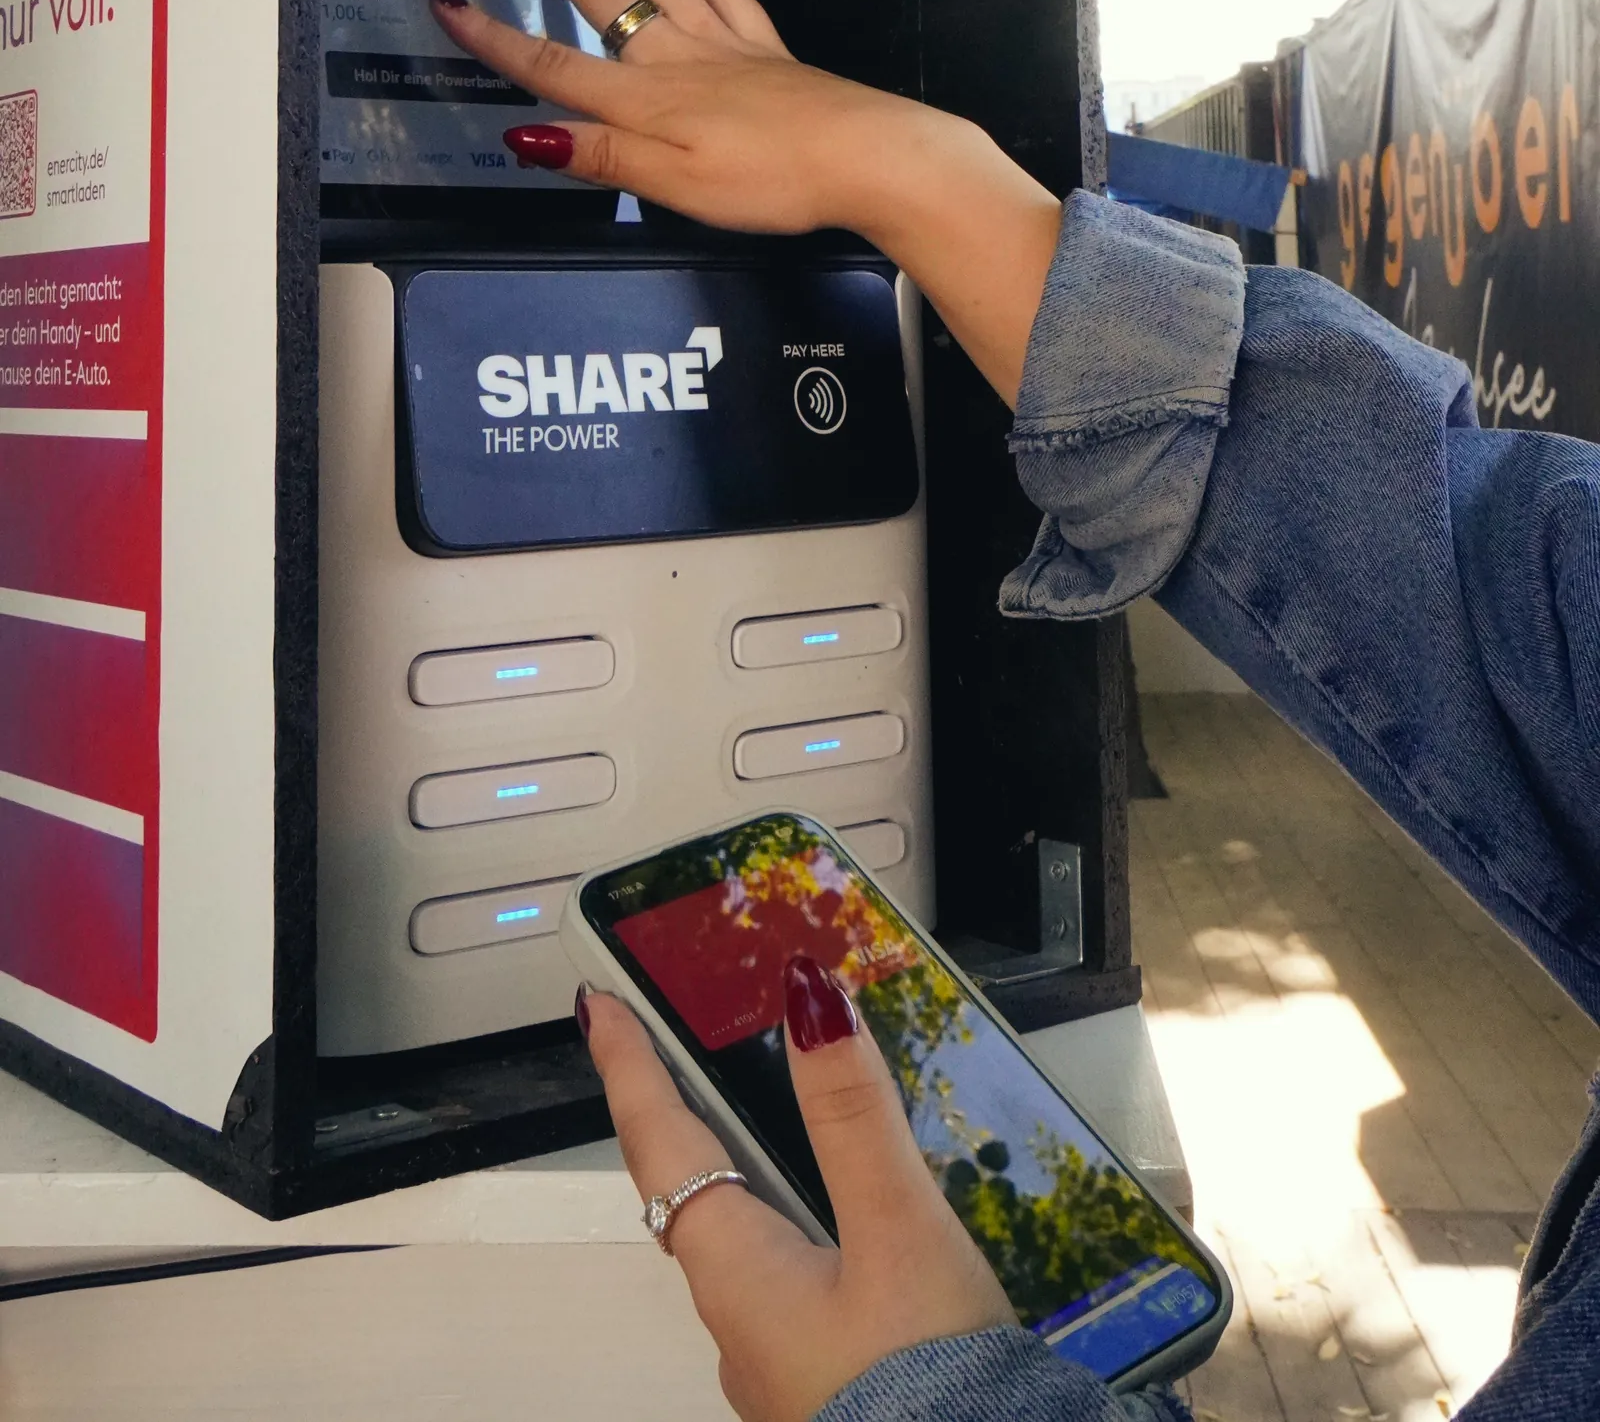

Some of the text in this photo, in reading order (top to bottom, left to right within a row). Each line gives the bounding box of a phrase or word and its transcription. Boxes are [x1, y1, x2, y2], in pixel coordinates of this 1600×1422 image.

[321, 3, 367, 22] 1,00€
[354, 68, 513, 90] Hol Dir eine Powerbank!
[46, 145, 110, 176] enercity.de/
[332, 149, 356, 165] Pay
[470, 152, 508, 168] VISA
[46, 180, 106, 207] smartladen
[24, 279, 57, 305] leicht
[60, 274, 122, 309] gemacht:
[11, 319, 37, 345] dein
[40, 318, 82, 349] Handy
[95, 316, 120, 343] und
[783, 342, 846, 358] PAY HERE
[35, 358, 61, 385] dein
[64, 359, 111, 386] E-Auto.
[476, 352, 710, 418] SHARE
[482, 423, 621, 454] THE POWER
[607, 883, 636, 901] 17:18
